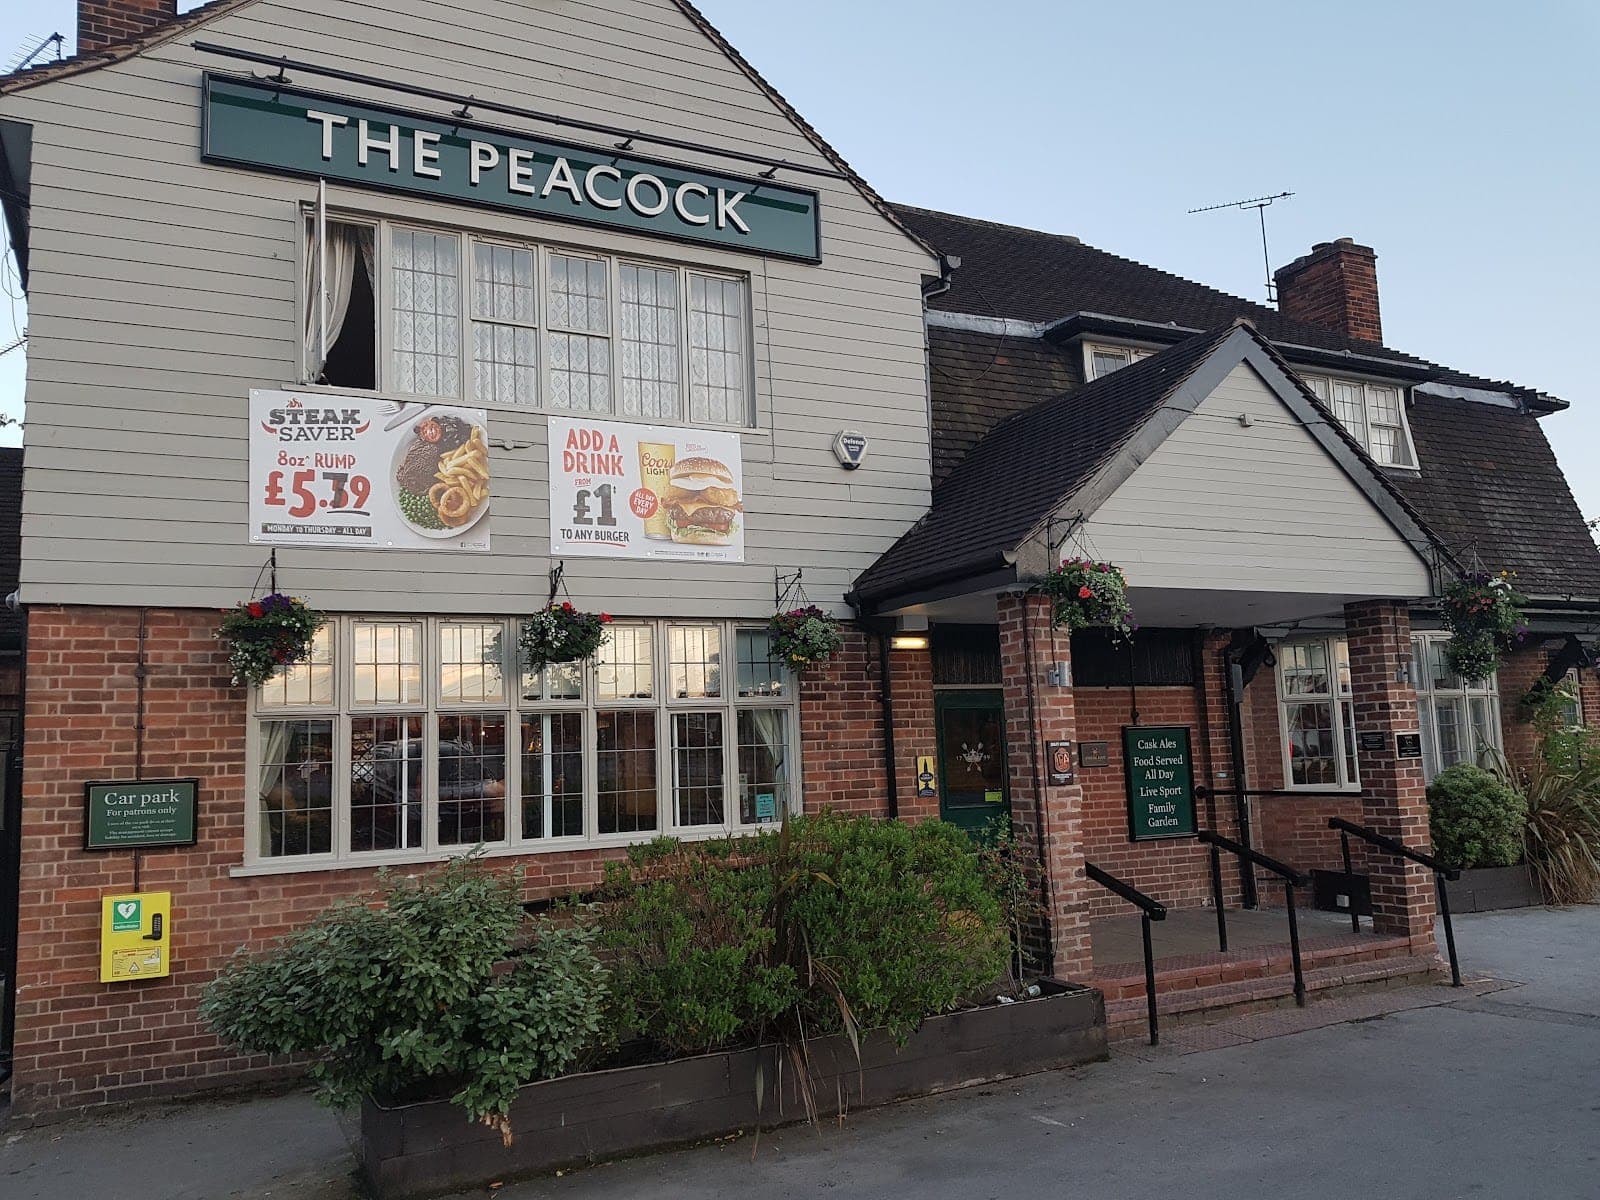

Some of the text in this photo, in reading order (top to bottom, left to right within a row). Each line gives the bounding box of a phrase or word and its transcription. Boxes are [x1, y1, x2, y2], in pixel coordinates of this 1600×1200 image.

[306, 109, 751, 233] THE PEACOCK
[269, 408, 361, 425] STEAK
[279, 426, 356, 442] SAVER
[566, 428, 619, 453] ADD A
[314, 452, 356, 469] RUMP
[563, 450, 624, 477] DRINK
[641, 452, 673, 469] Coors
[574, 478, 592, 486] FROM
[635, 491, 645, 500] ALL
[634, 498, 655, 510] EVERY
[636, 505, 649, 515] DAY
[267, 523, 294, 533] MONDAY
[304, 525, 337, 535] THURSDAY
[342, 527, 354, 535] ALL
[355, 527, 368, 536] DAY
[560, 529, 630, 542] TO ANY BURGER
[1137, 737, 1177, 750] Cask Ales
[1133, 754, 1183, 767] Food Served
[1145, 769, 1175, 780] All Day
[104, 788, 180, 807] Car park
[1140, 786, 1182, 798] Live Sport
[106, 805, 177, 818] For patrons only
[1148, 802, 1176, 814] Family
[1148, 816, 1178, 827] Garden
